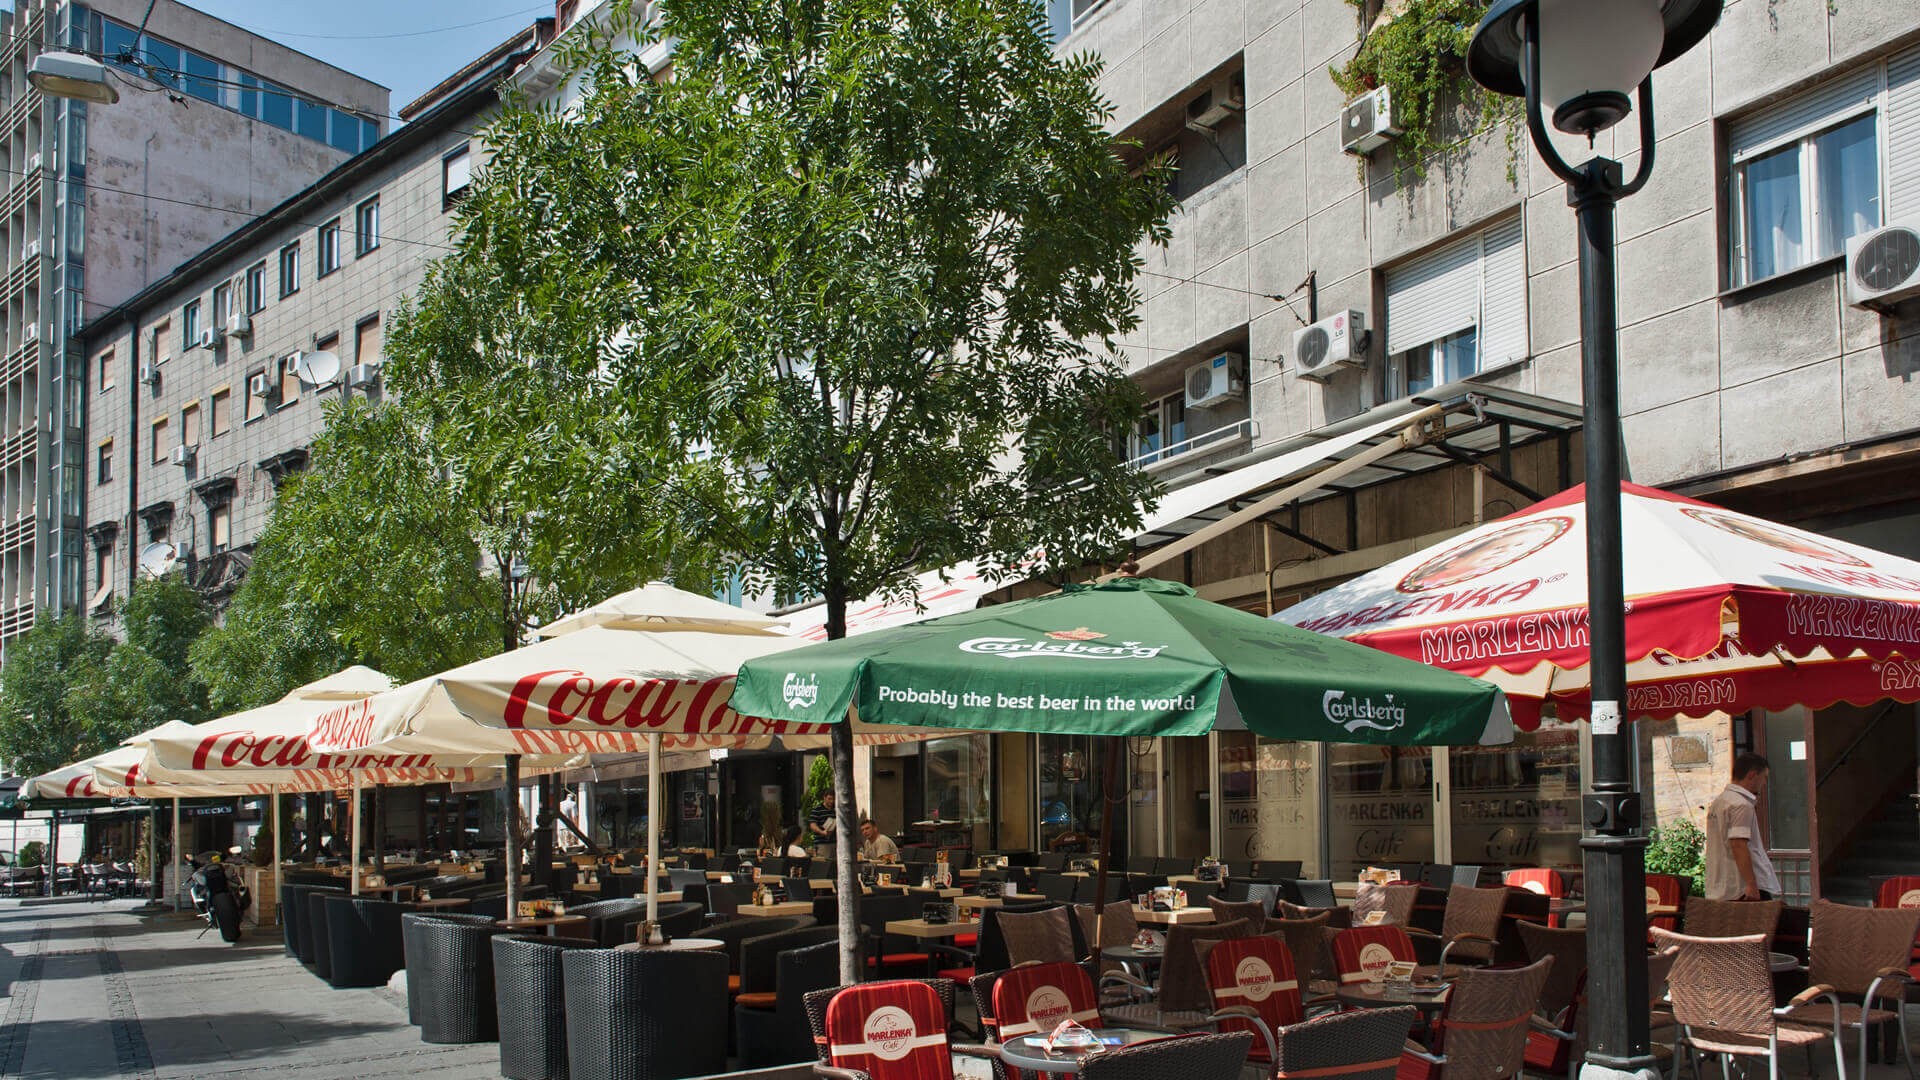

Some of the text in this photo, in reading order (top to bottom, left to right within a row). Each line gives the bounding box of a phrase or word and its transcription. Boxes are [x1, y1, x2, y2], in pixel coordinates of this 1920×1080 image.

[958, 636, 1163, 659] Carlsberg
[1420, 606, 1590, 665] MARLENK
[782, 672, 819, 710] Carlsberg
[879, 686, 1195, 712] Probably the best beer in the world
[1322, 689, 1406, 733] Carlsberg
[867, 1028, 913, 1040] MARLENKA
